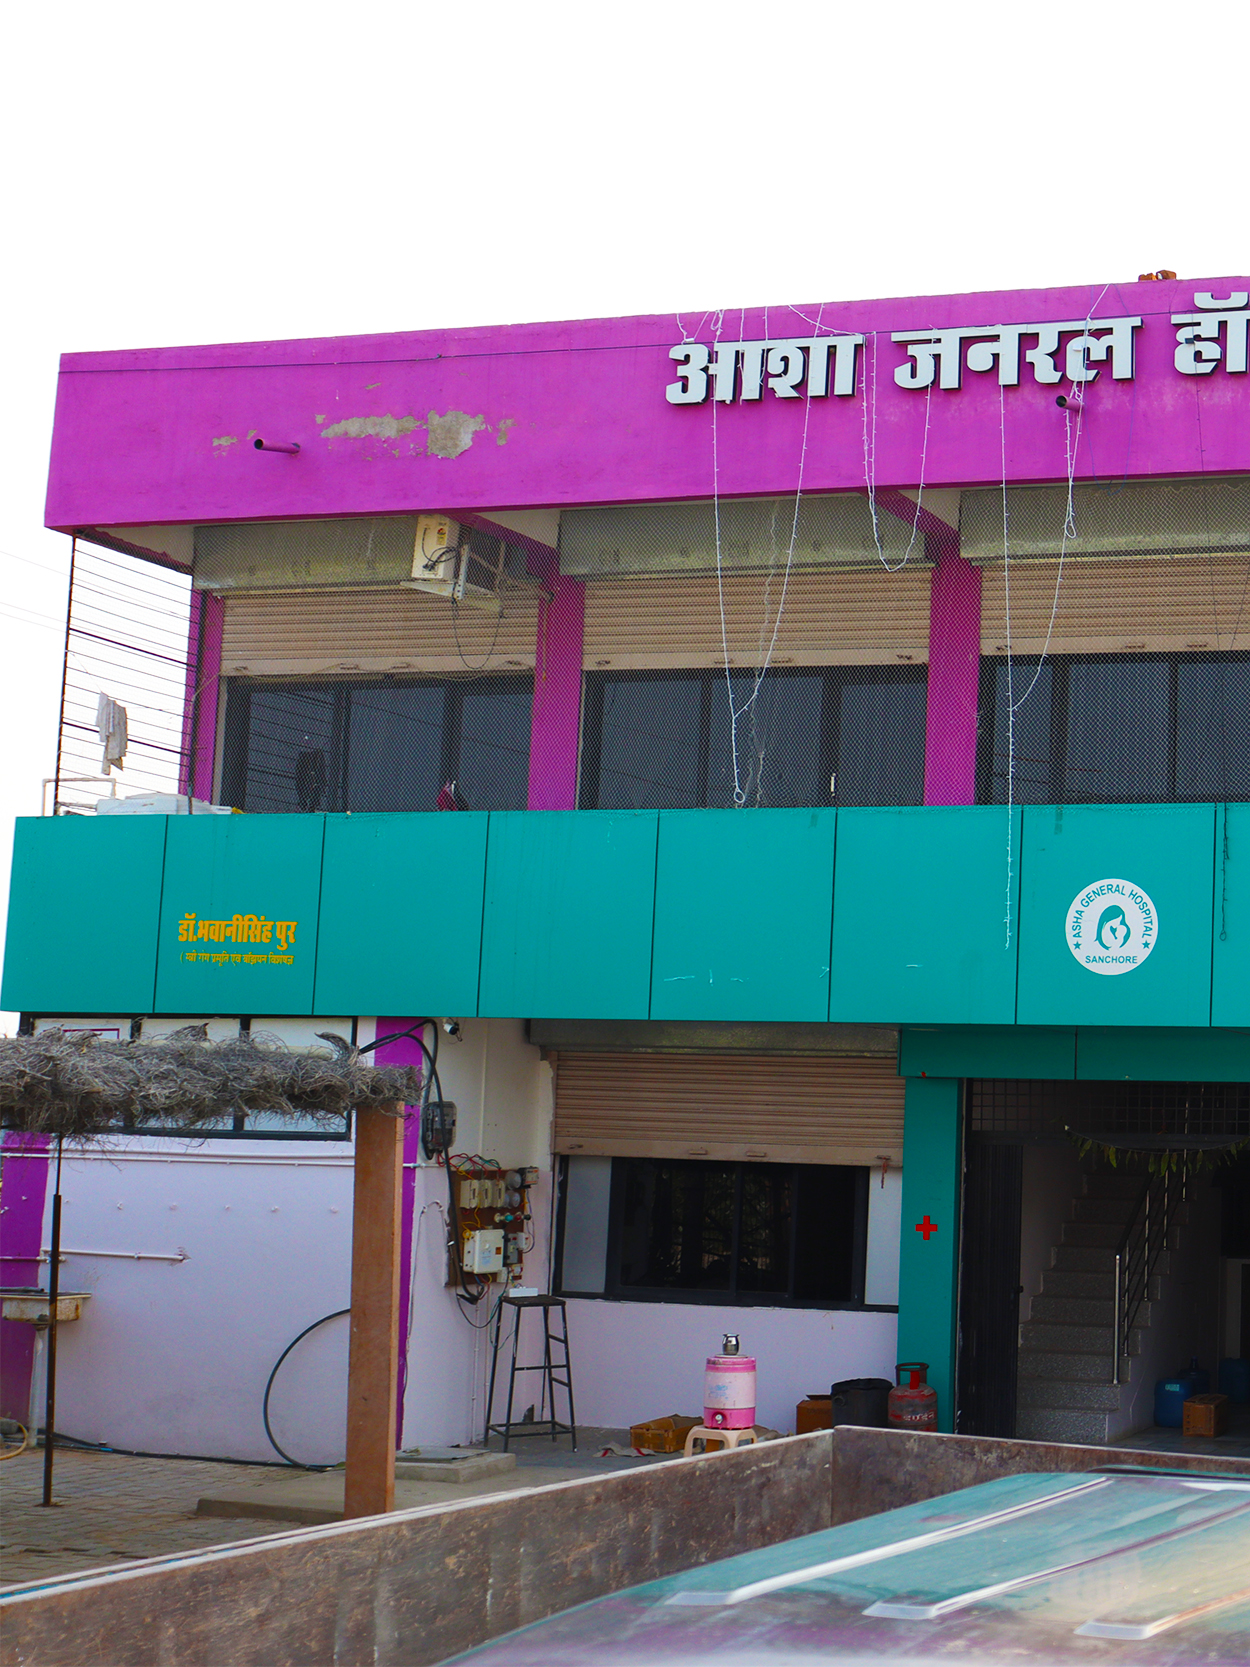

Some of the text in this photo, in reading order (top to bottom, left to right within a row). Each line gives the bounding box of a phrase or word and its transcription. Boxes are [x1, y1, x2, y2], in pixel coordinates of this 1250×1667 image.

[665, 333, 865, 405] आशा
[892, 316, 1142, 389] जनरल
[1071, 883, 1153, 938] ASHA GENERAL HOSPITAL
[276, 921, 298, 950] पुर
[1085, 955, 1138, 964] SANCHORE
